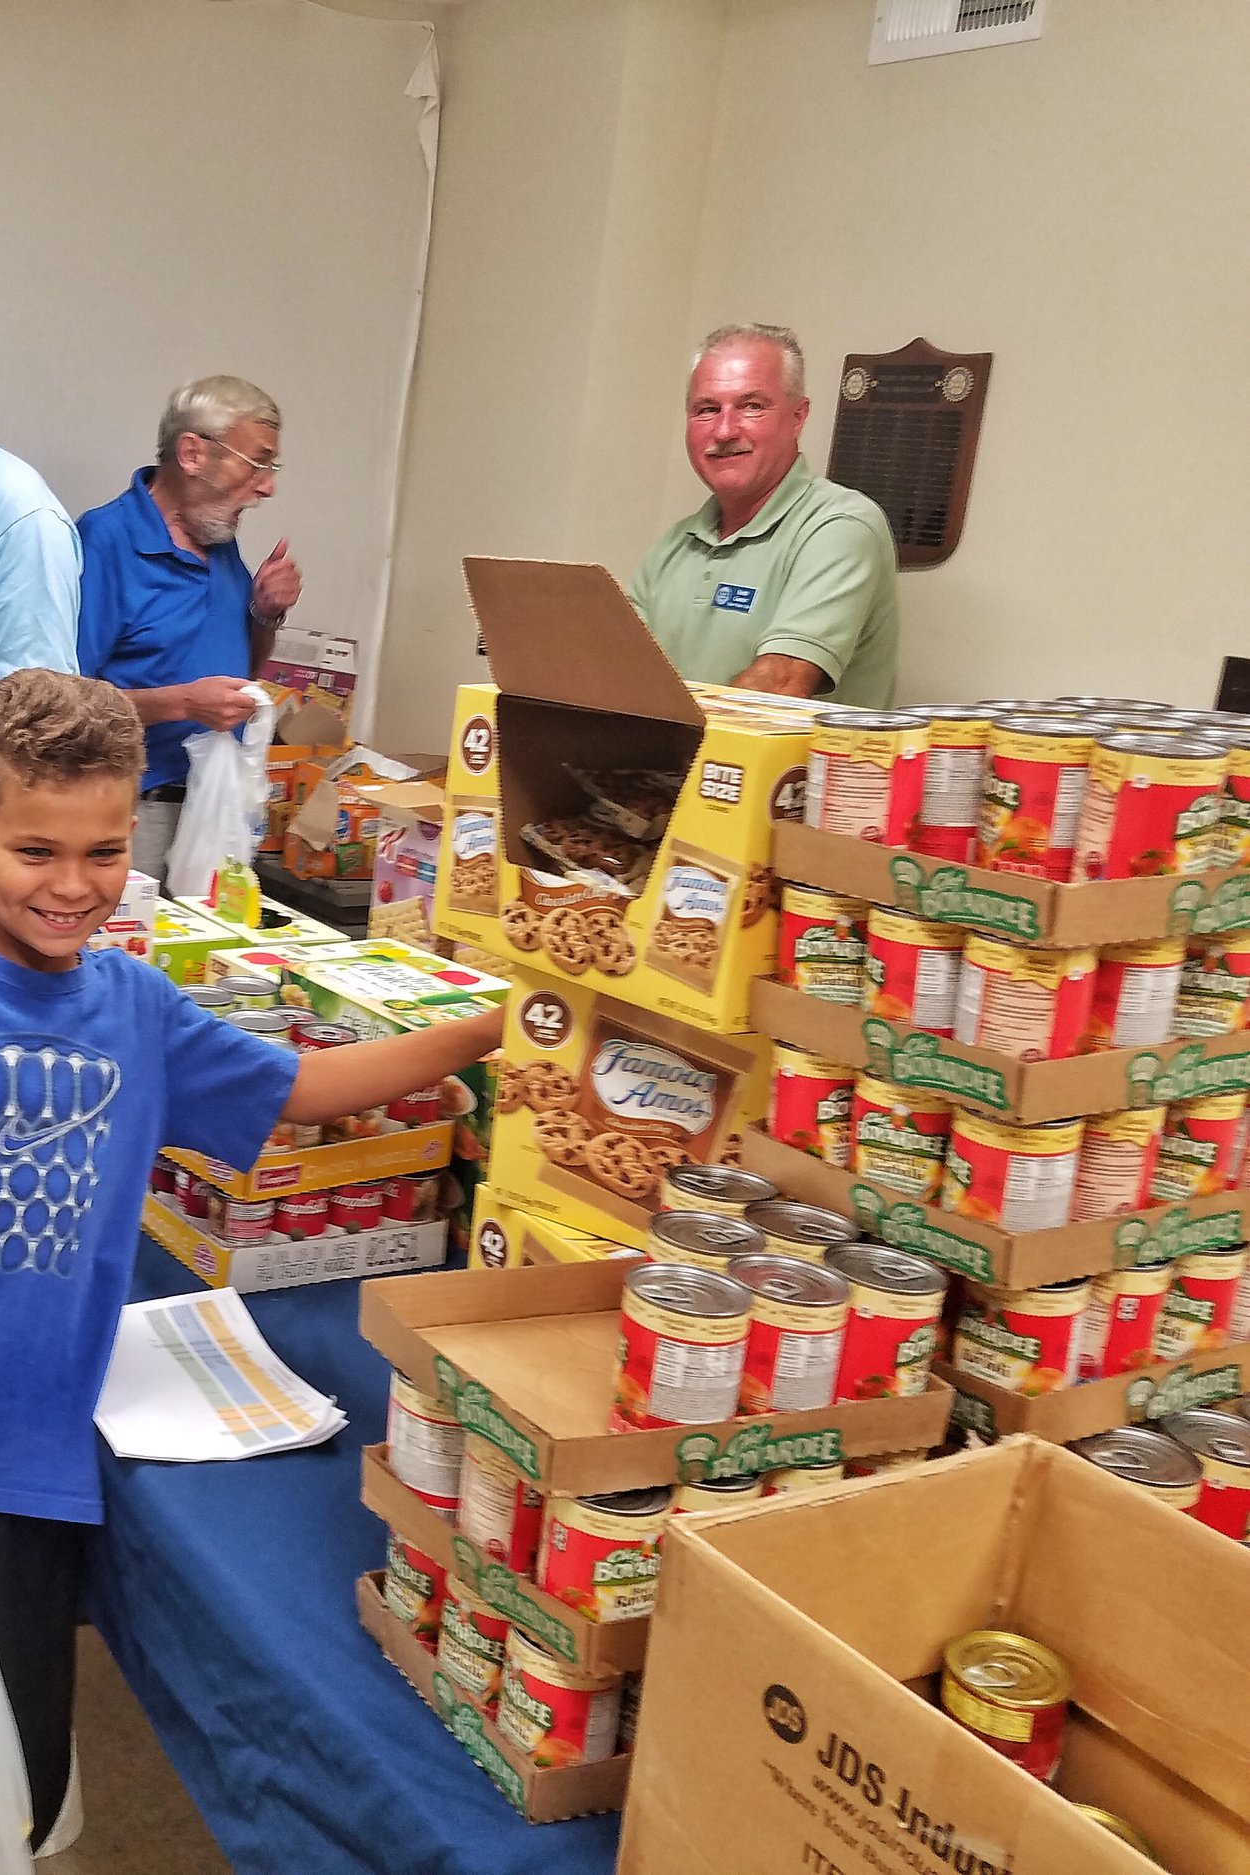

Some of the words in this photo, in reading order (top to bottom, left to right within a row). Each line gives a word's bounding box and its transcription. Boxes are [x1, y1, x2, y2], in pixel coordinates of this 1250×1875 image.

[464, 719, 490, 752] 42
[703, 763, 743, 785] BITE
[701, 780, 740, 802] SIZE
[524, 1002, 563, 1029] 42
[816, 1732, 887, 1807] JDS
